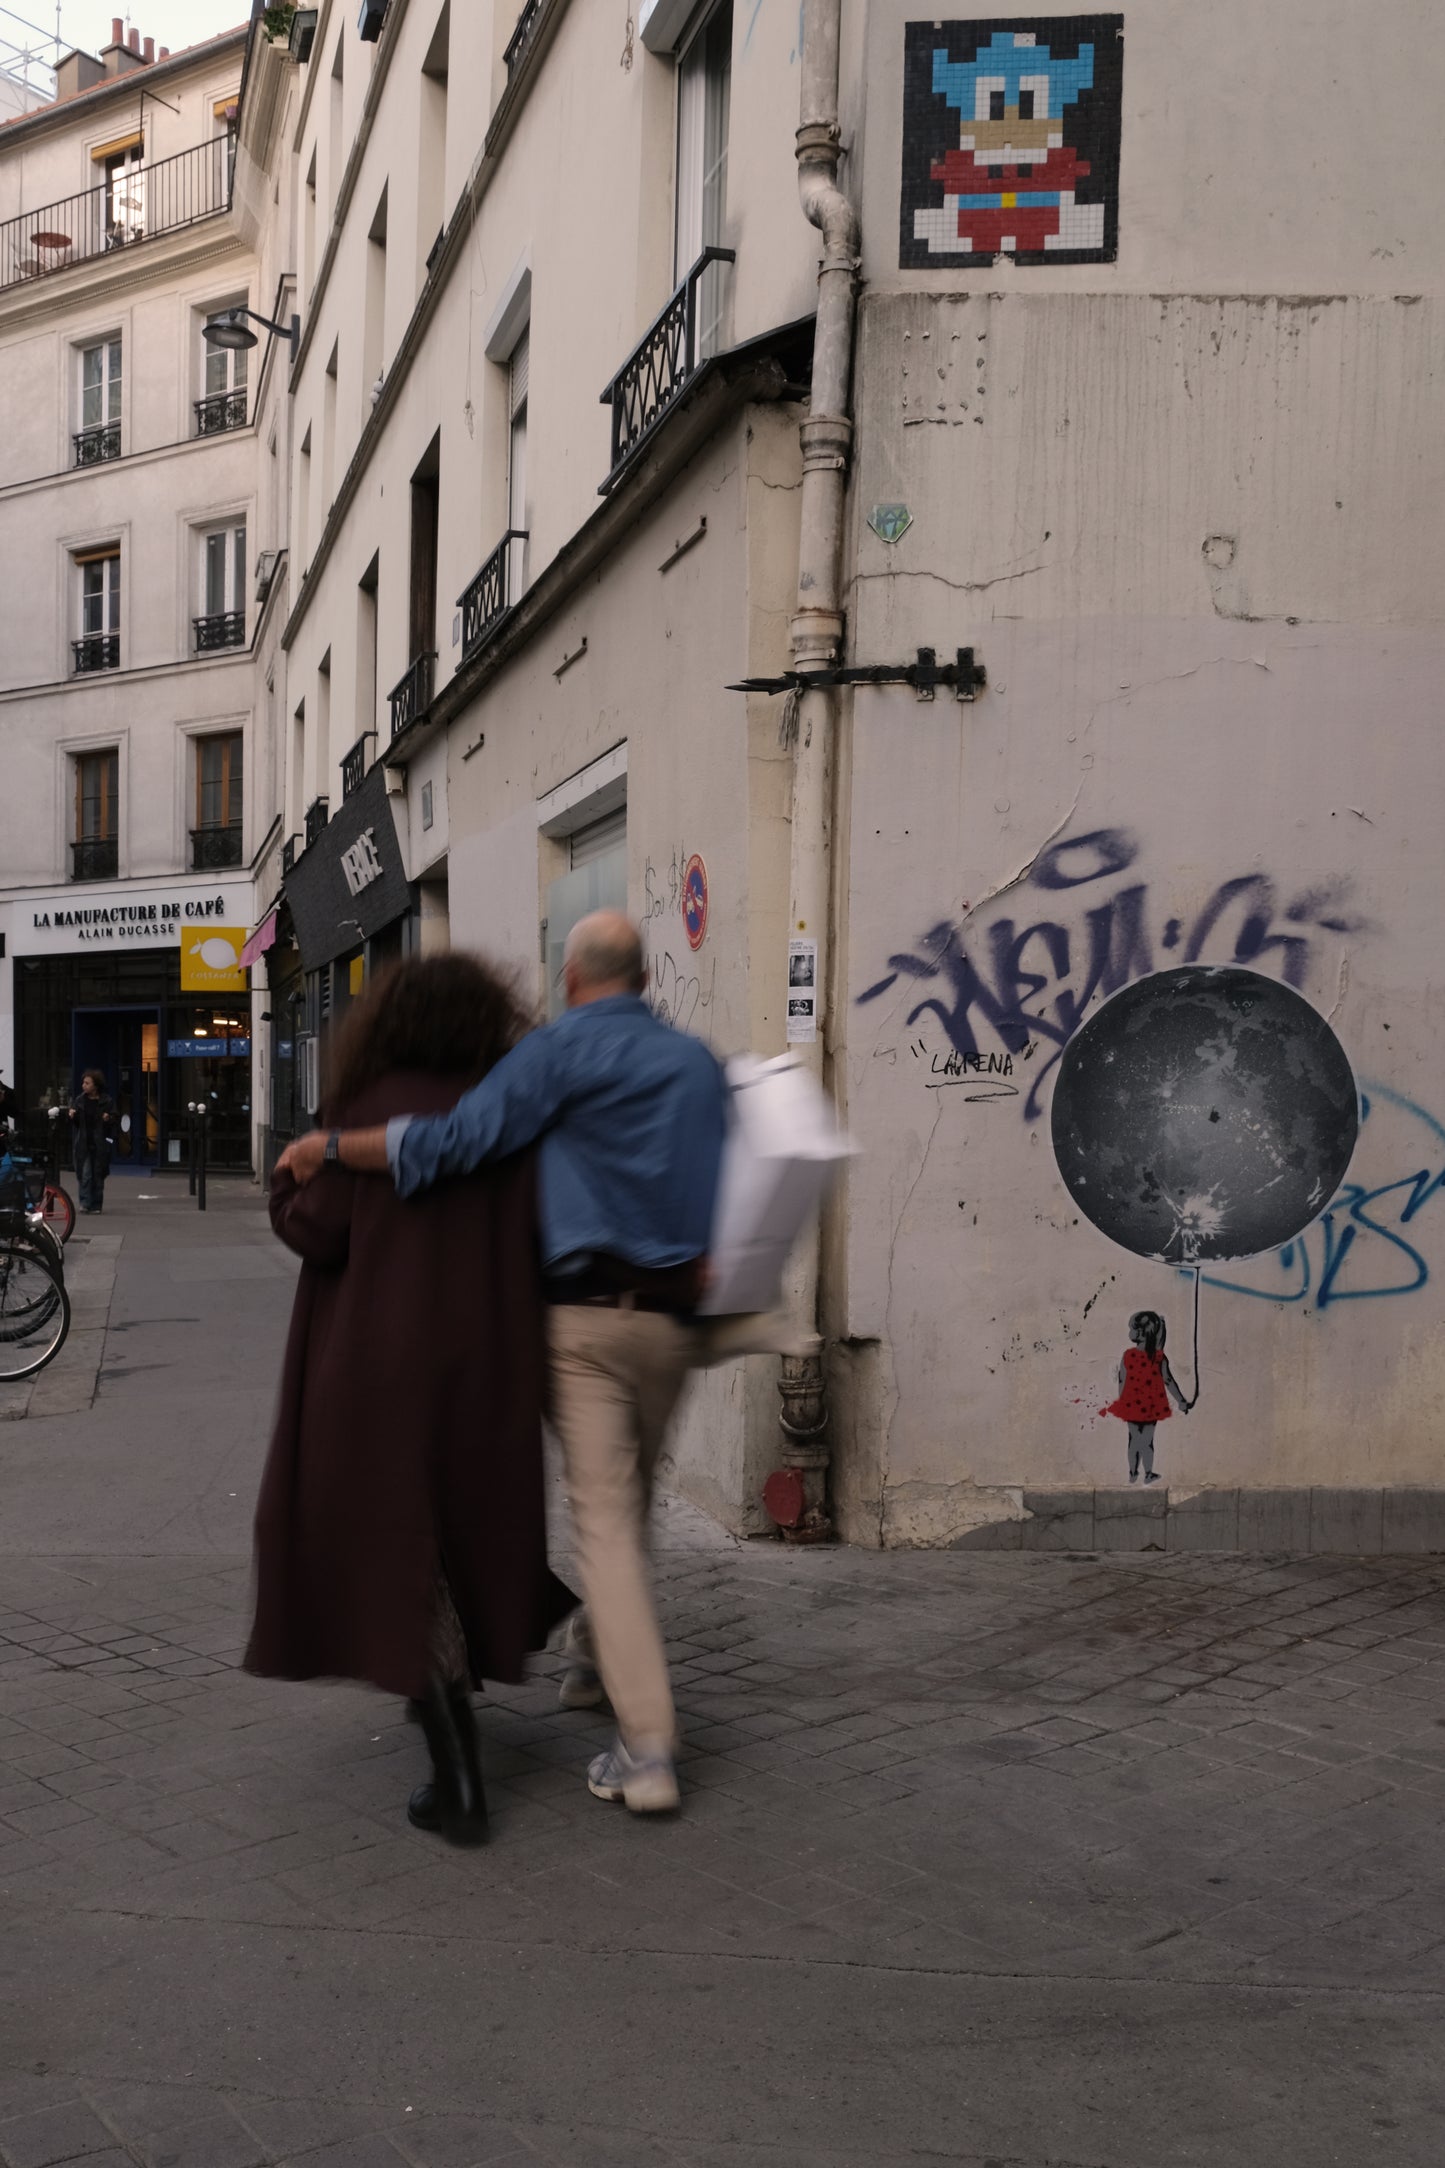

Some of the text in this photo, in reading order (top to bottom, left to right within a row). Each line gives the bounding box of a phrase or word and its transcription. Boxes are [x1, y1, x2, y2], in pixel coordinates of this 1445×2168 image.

[33, 895, 225, 928] LA MANUFACTURE DE CAFÉ
[78, 923, 175, 939] ALAIN DUCASSE
